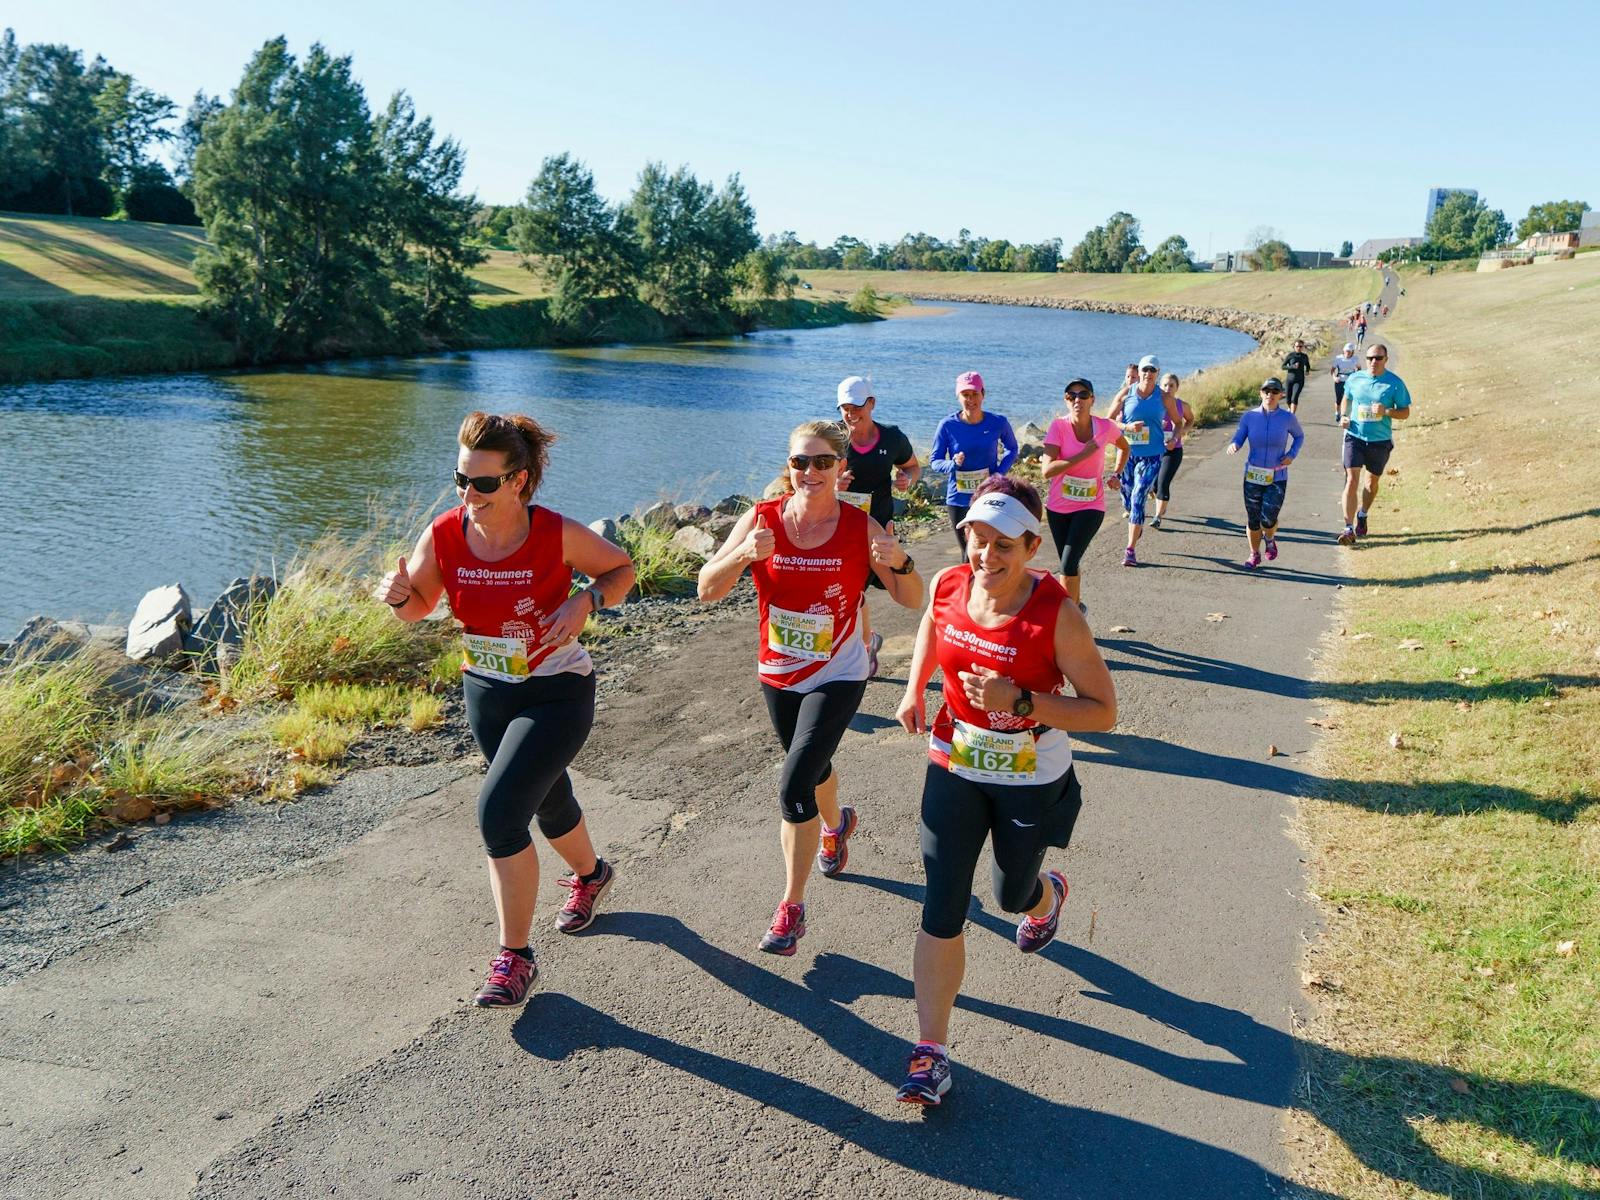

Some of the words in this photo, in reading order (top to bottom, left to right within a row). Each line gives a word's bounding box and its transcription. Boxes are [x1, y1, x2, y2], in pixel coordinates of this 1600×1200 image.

[1069, 485, 1088, 497] 171
[773, 553, 843, 566] five30runners
[457, 567, 533, 579] five30runners
[780, 614, 817, 625] MAITLAND
[781, 628, 814, 651] 128
[943, 635, 953, 644] five
[968, 645, 977, 653] 30
[996, 654, 1008, 662] run
[944, 623, 1018, 656] five30runners
[473, 652, 508, 673] 201
[969, 749, 1013, 772] 162
